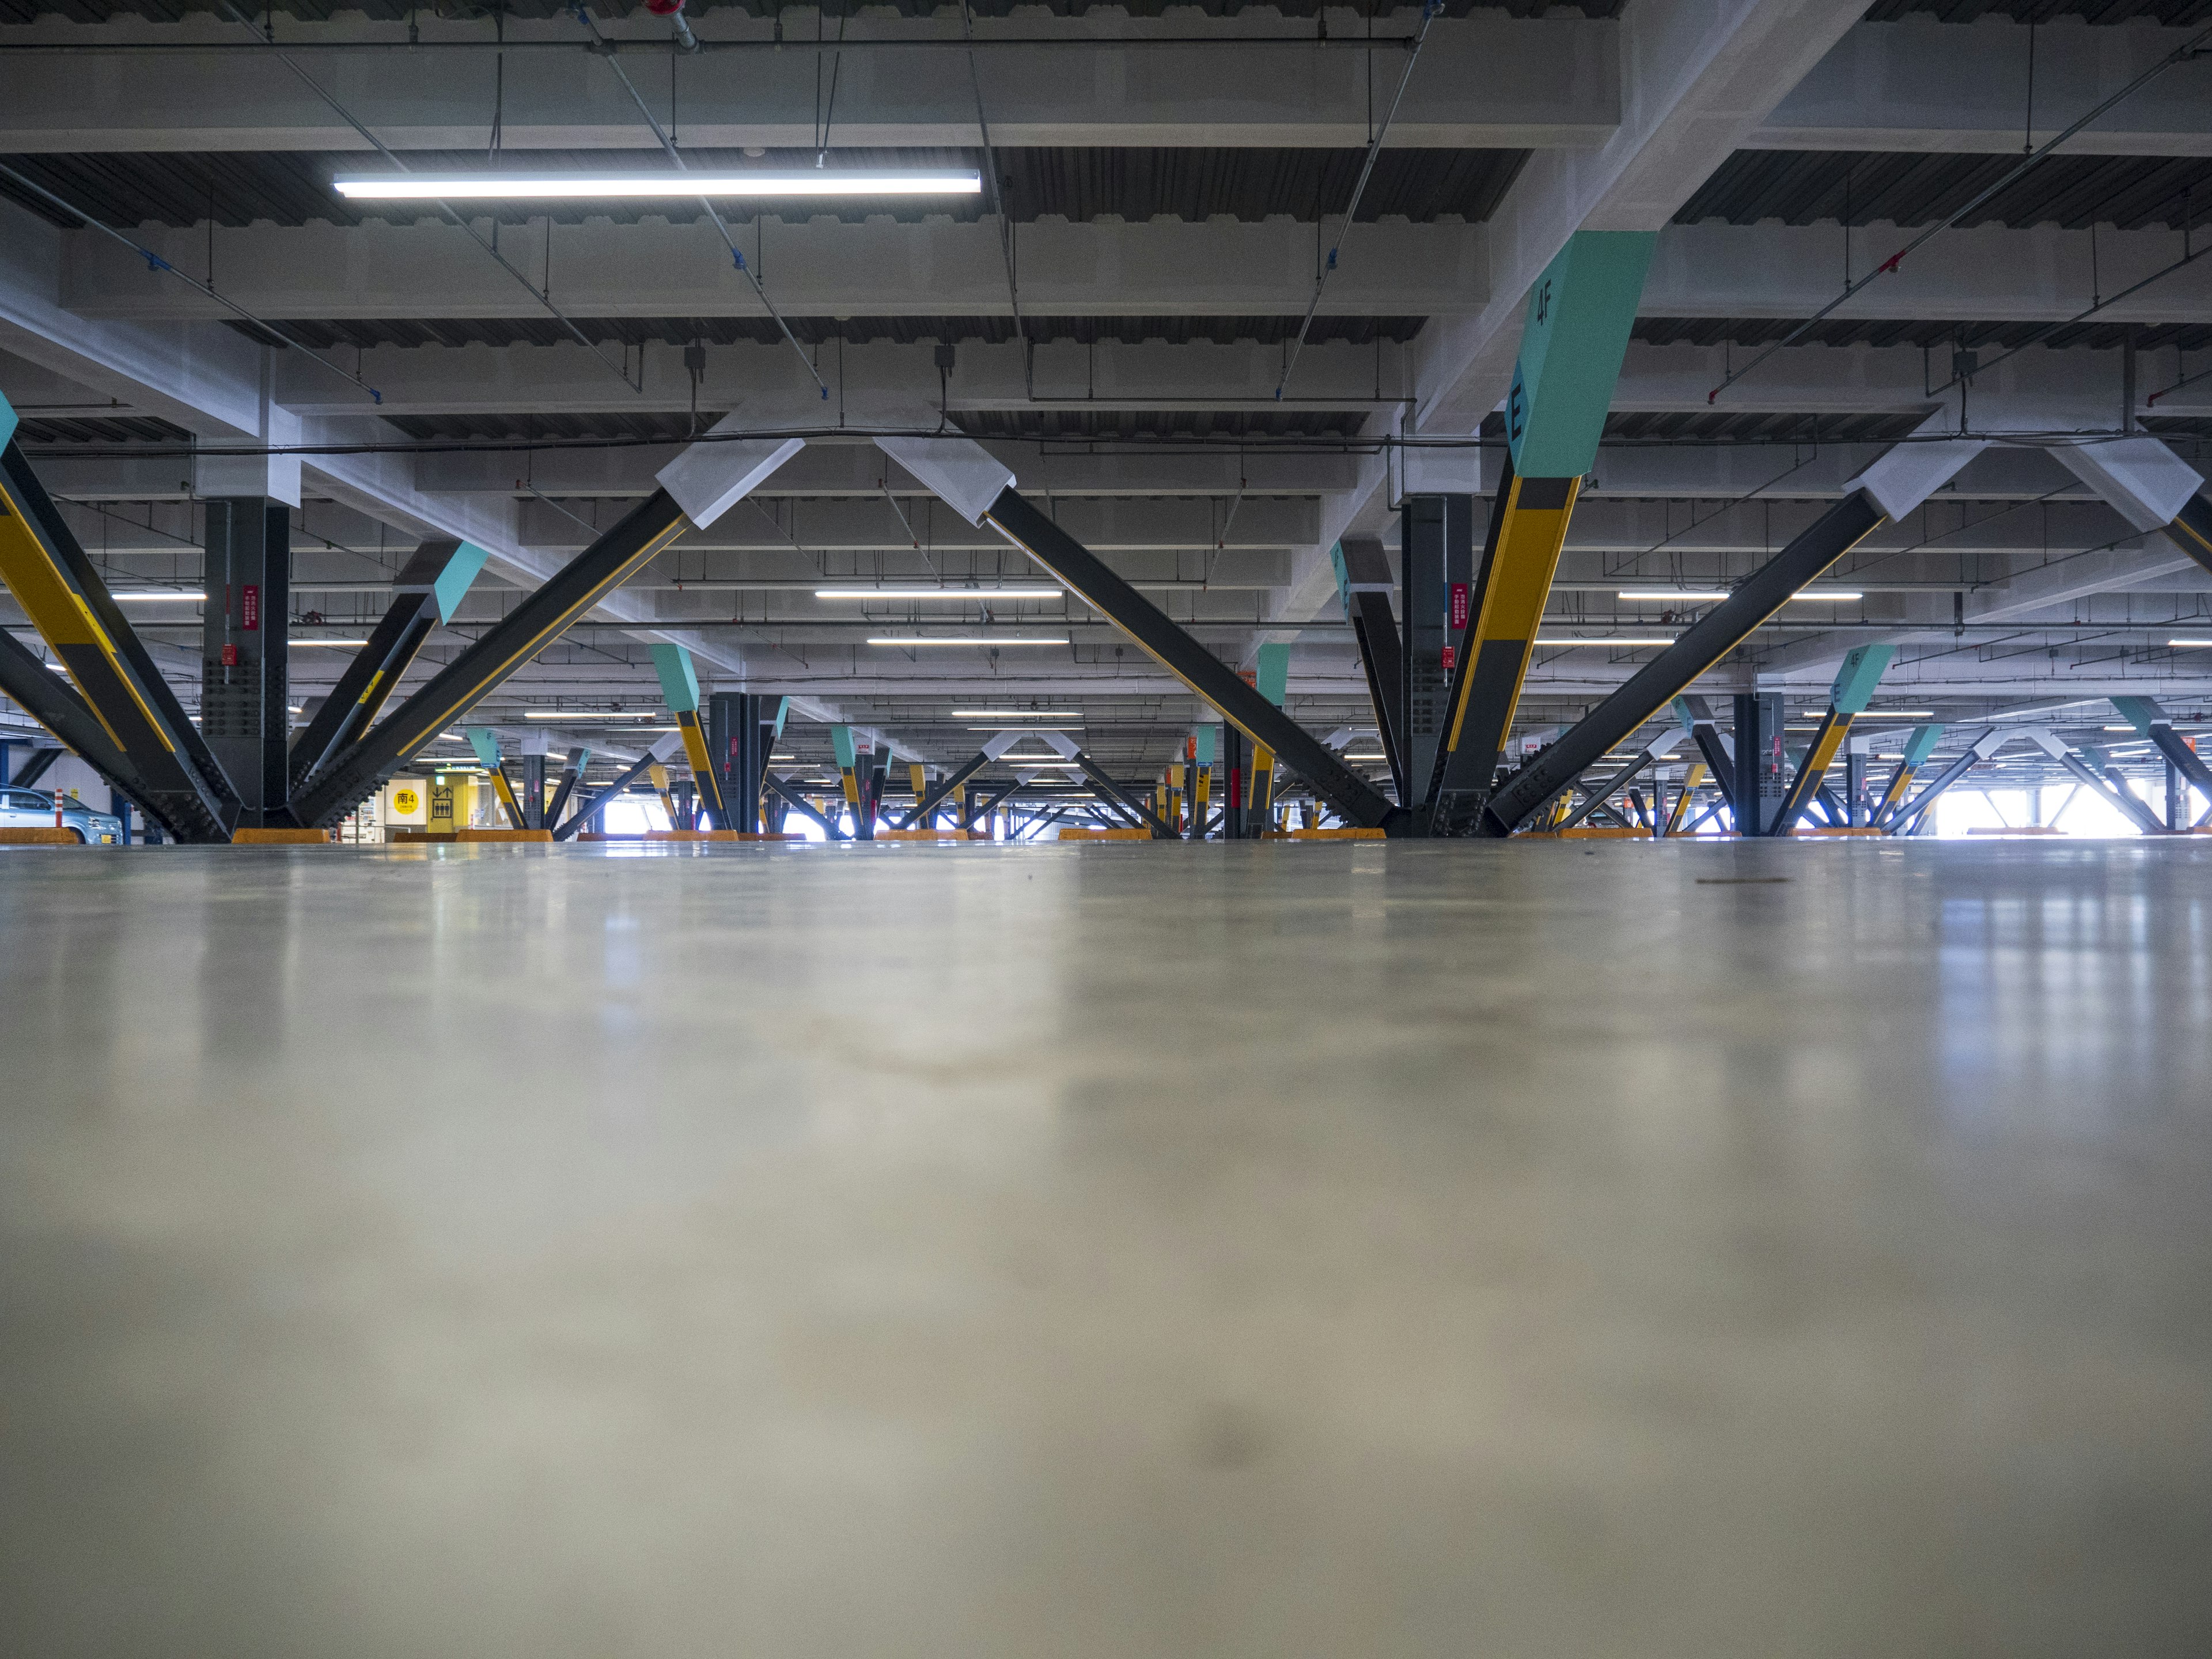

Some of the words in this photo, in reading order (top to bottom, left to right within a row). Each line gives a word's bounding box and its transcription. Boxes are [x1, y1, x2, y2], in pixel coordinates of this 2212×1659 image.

[1537, 279, 1551, 326] 4F
[1511, 383, 1521, 441] E
[1344, 579, 1348, 610] E
[1851, 653, 1859, 668] 4F
[1834, 683, 1841, 702] E
[1687, 717, 1691, 732] E
[497, 750, 500, 762] E
